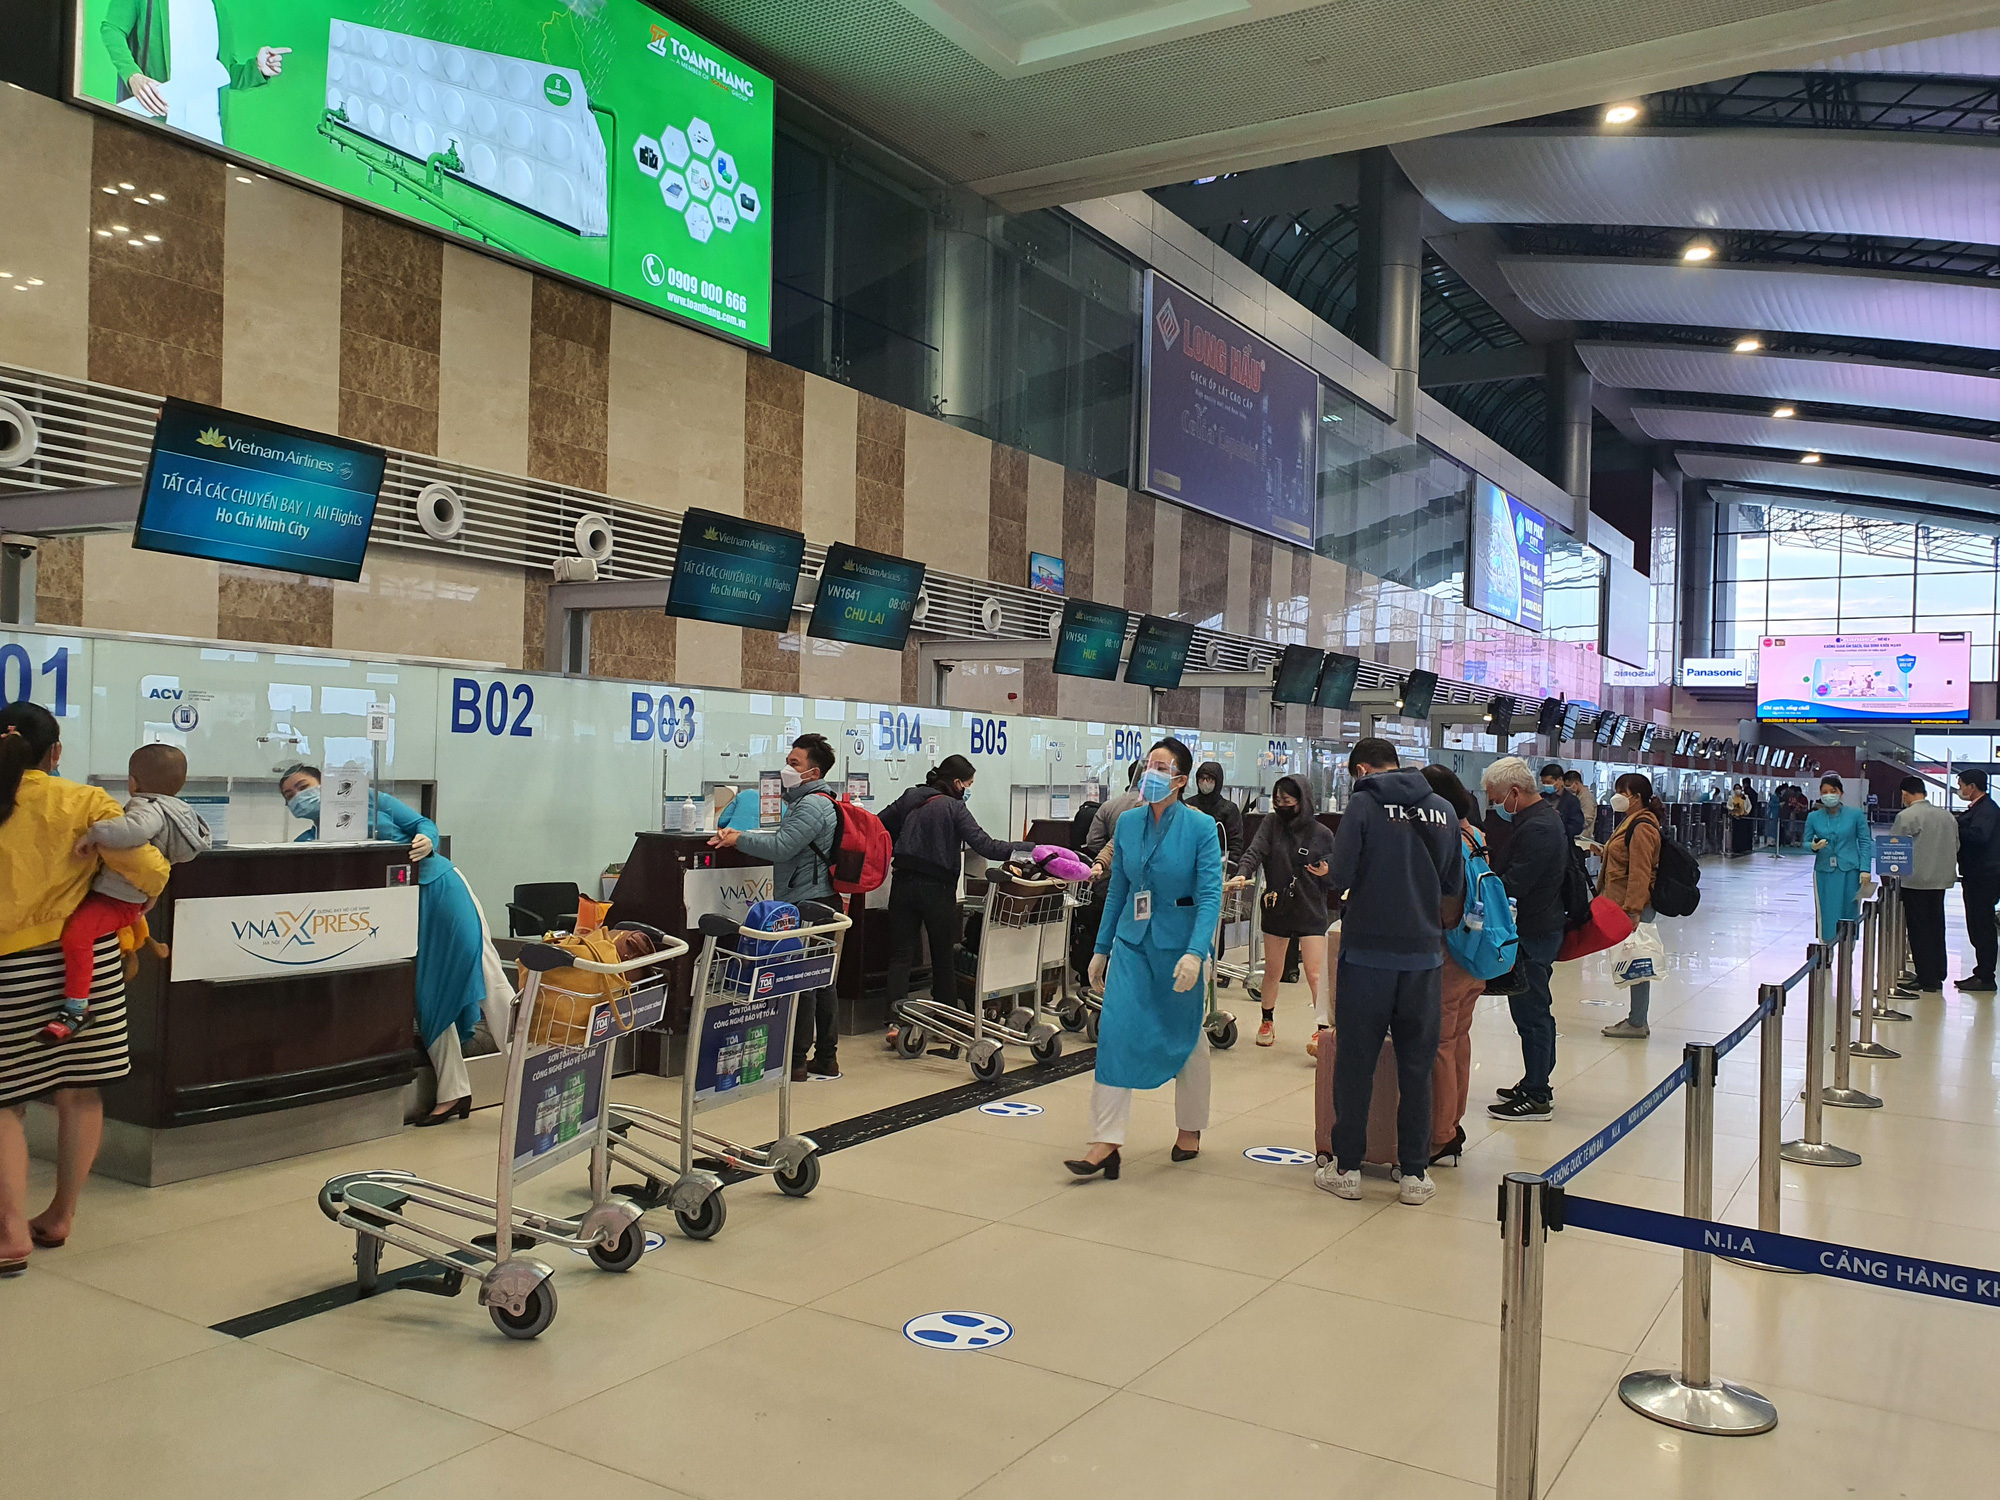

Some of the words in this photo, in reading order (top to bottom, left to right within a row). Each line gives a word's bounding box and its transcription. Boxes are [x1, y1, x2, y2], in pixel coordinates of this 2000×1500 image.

[670, 37, 754, 97] TOANTHANG
[681, 61, 702, 77] MEMBER
[667, 267, 698, 295] 0909
[700, 280, 723, 305] 000
[725, 289, 747, 314] 666
[667, 292, 747, 329] www.toanthang.com.vn
[1183, 318, 1227, 376] LONG
[228, 436, 284, 461] Vietnam
[285, 451, 334, 472] Airlines
[162, 472, 184, 492] TẤT
[186, 477, 202, 496] CẢ
[205, 482, 230, 501] CÁC
[231, 488, 279, 510] CHUYẾN
[280, 498, 303, 516] BAY
[314, 505, 328, 519] All
[330, 507, 363, 527] Flights
[216, 507, 233, 524] Ho
[235, 511, 253, 528] Chi
[256, 515, 286, 533] Minh
[288, 520, 310, 540] City
[719, 532, 750, 548] Vietnam
[750, 540, 776, 553] Airlines
[705, 565, 719, 578] CÁC
[746, 573, 758, 586] BAY
[763, 578, 772, 588] All
[772, 579, 791, 593] Flights
[855, 563, 880, 577] Vietnam
[710, 583, 719, 594] Ho
[721, 585, 732, 597] Chi
[732, 587, 748, 599] Minh
[749, 590, 762, 604] City
[828, 584, 861, 602] VN1641
[888, 597, 911, 612] 08:00
[844, 606, 868, 622] CHU
[868, 611, 885, 625] LAI
[1687, 668, 1742, 677] Panasonic
[149, 688, 183, 700] ACV
[451, 677, 534, 737] B02
[630, 691, 695, 743] B03
[661, 717, 680, 726] ACV
[878, 711, 922, 752] B04
[971, 717, 1008, 755] B05
[1115, 729, 1142, 761] B06
[1453, 753, 1464, 773] B11
[760, 978, 772, 987] TOA
[741, 1005, 751, 1013] TOA
[752, 1002, 767, 1010] NANO
[596, 1017, 608, 1030] TOA
[713, 1019, 729, 1029] CÔNG
[730, 1015, 744, 1025] NGHỆ
[745, 1012, 756, 1022] BẢO
[756, 1010, 763, 1020] VỆ
[726, 1035, 739, 1045] TOA
[751, 1028, 763, 1039] TOA
[532, 1069, 548, 1081] CÔNG
[570, 1075, 581, 1088] TOA
[544, 1085, 557, 1099] TOA
[1704, 1229, 1756, 1255] N.I.A
[1819, 1249, 1888, 1279] CẢNG
[1896, 1264, 1969, 1294] HÀNG
